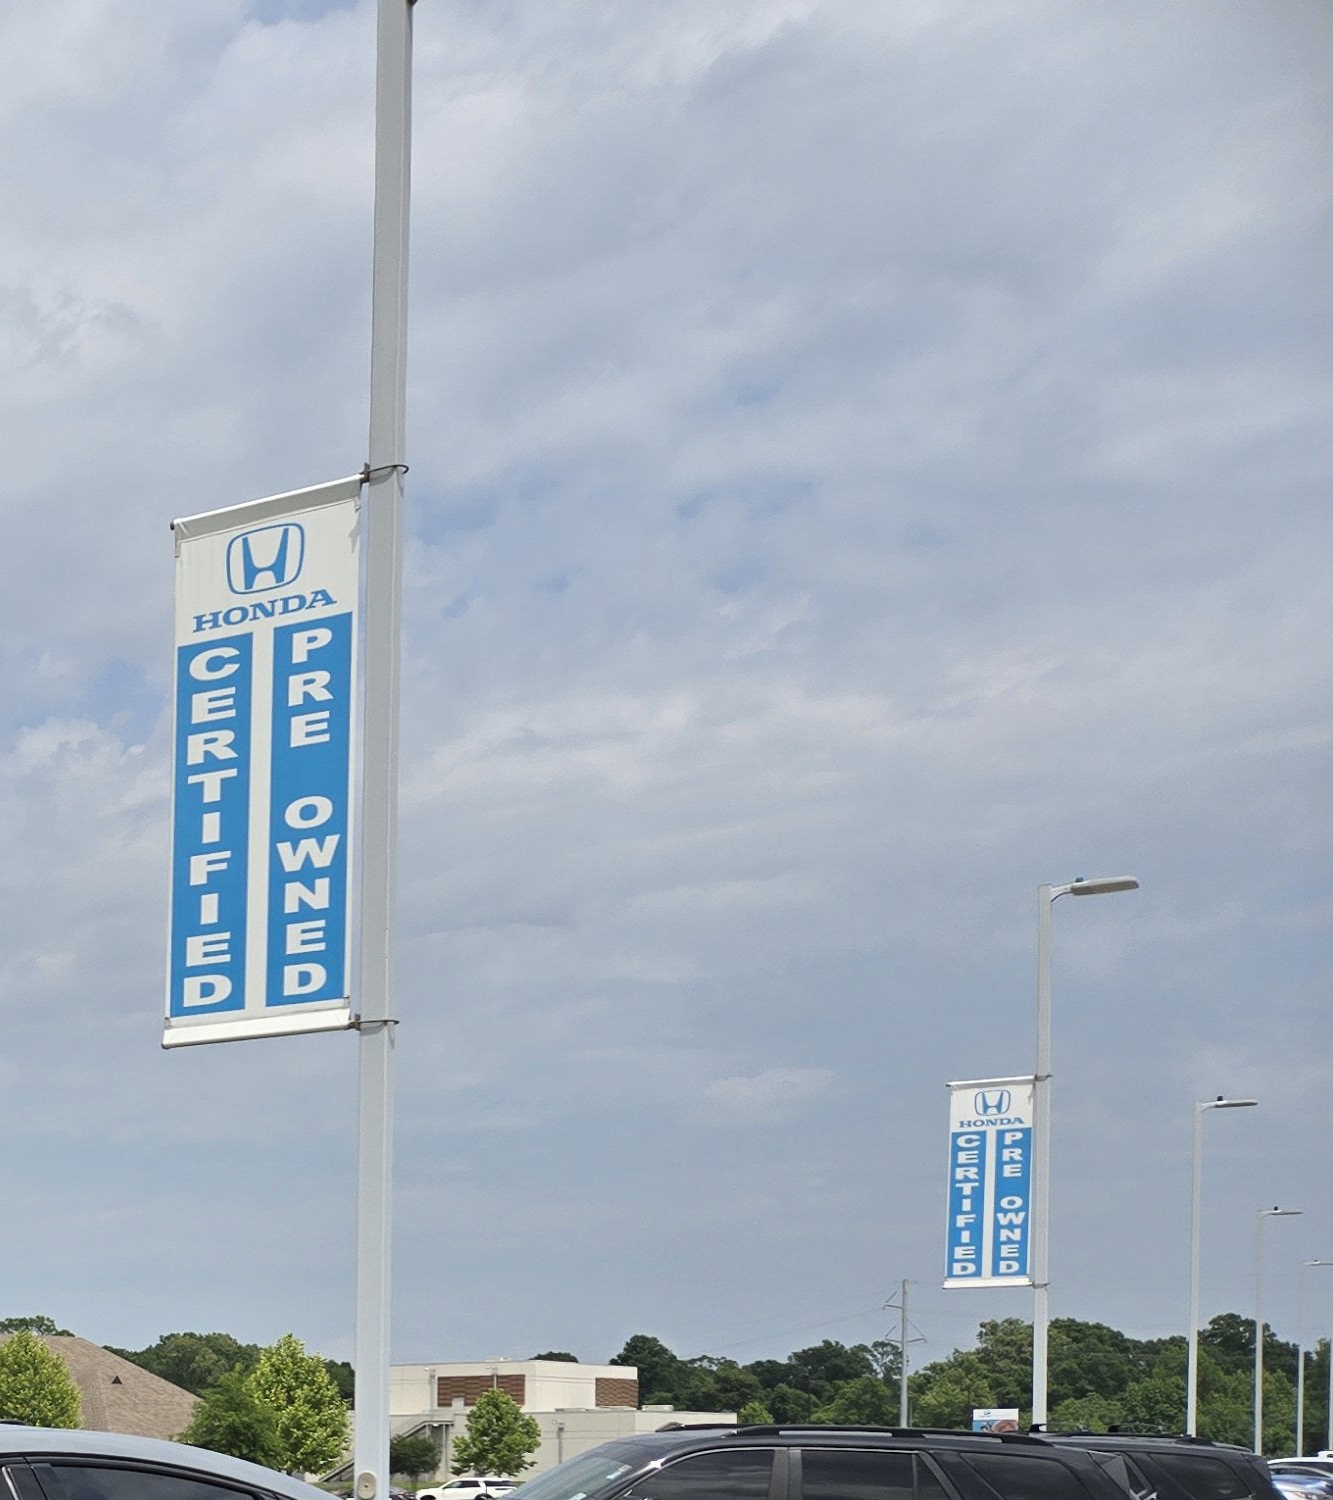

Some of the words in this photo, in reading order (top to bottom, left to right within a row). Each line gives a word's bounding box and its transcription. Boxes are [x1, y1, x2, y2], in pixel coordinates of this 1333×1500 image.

[193, 588, 337, 633] HONDA
[288, 627, 333, 748] PRE
[183, 647, 240, 1008] CERTIFIED
[276, 794, 340, 998] OWNED
[959, 1117, 1025, 1128] HONDA
[1001, 1131, 1023, 1177] PRE
[952, 1134, 981, 1276] CERTIFIED
[996, 1196, 1026, 1274] OWNED
